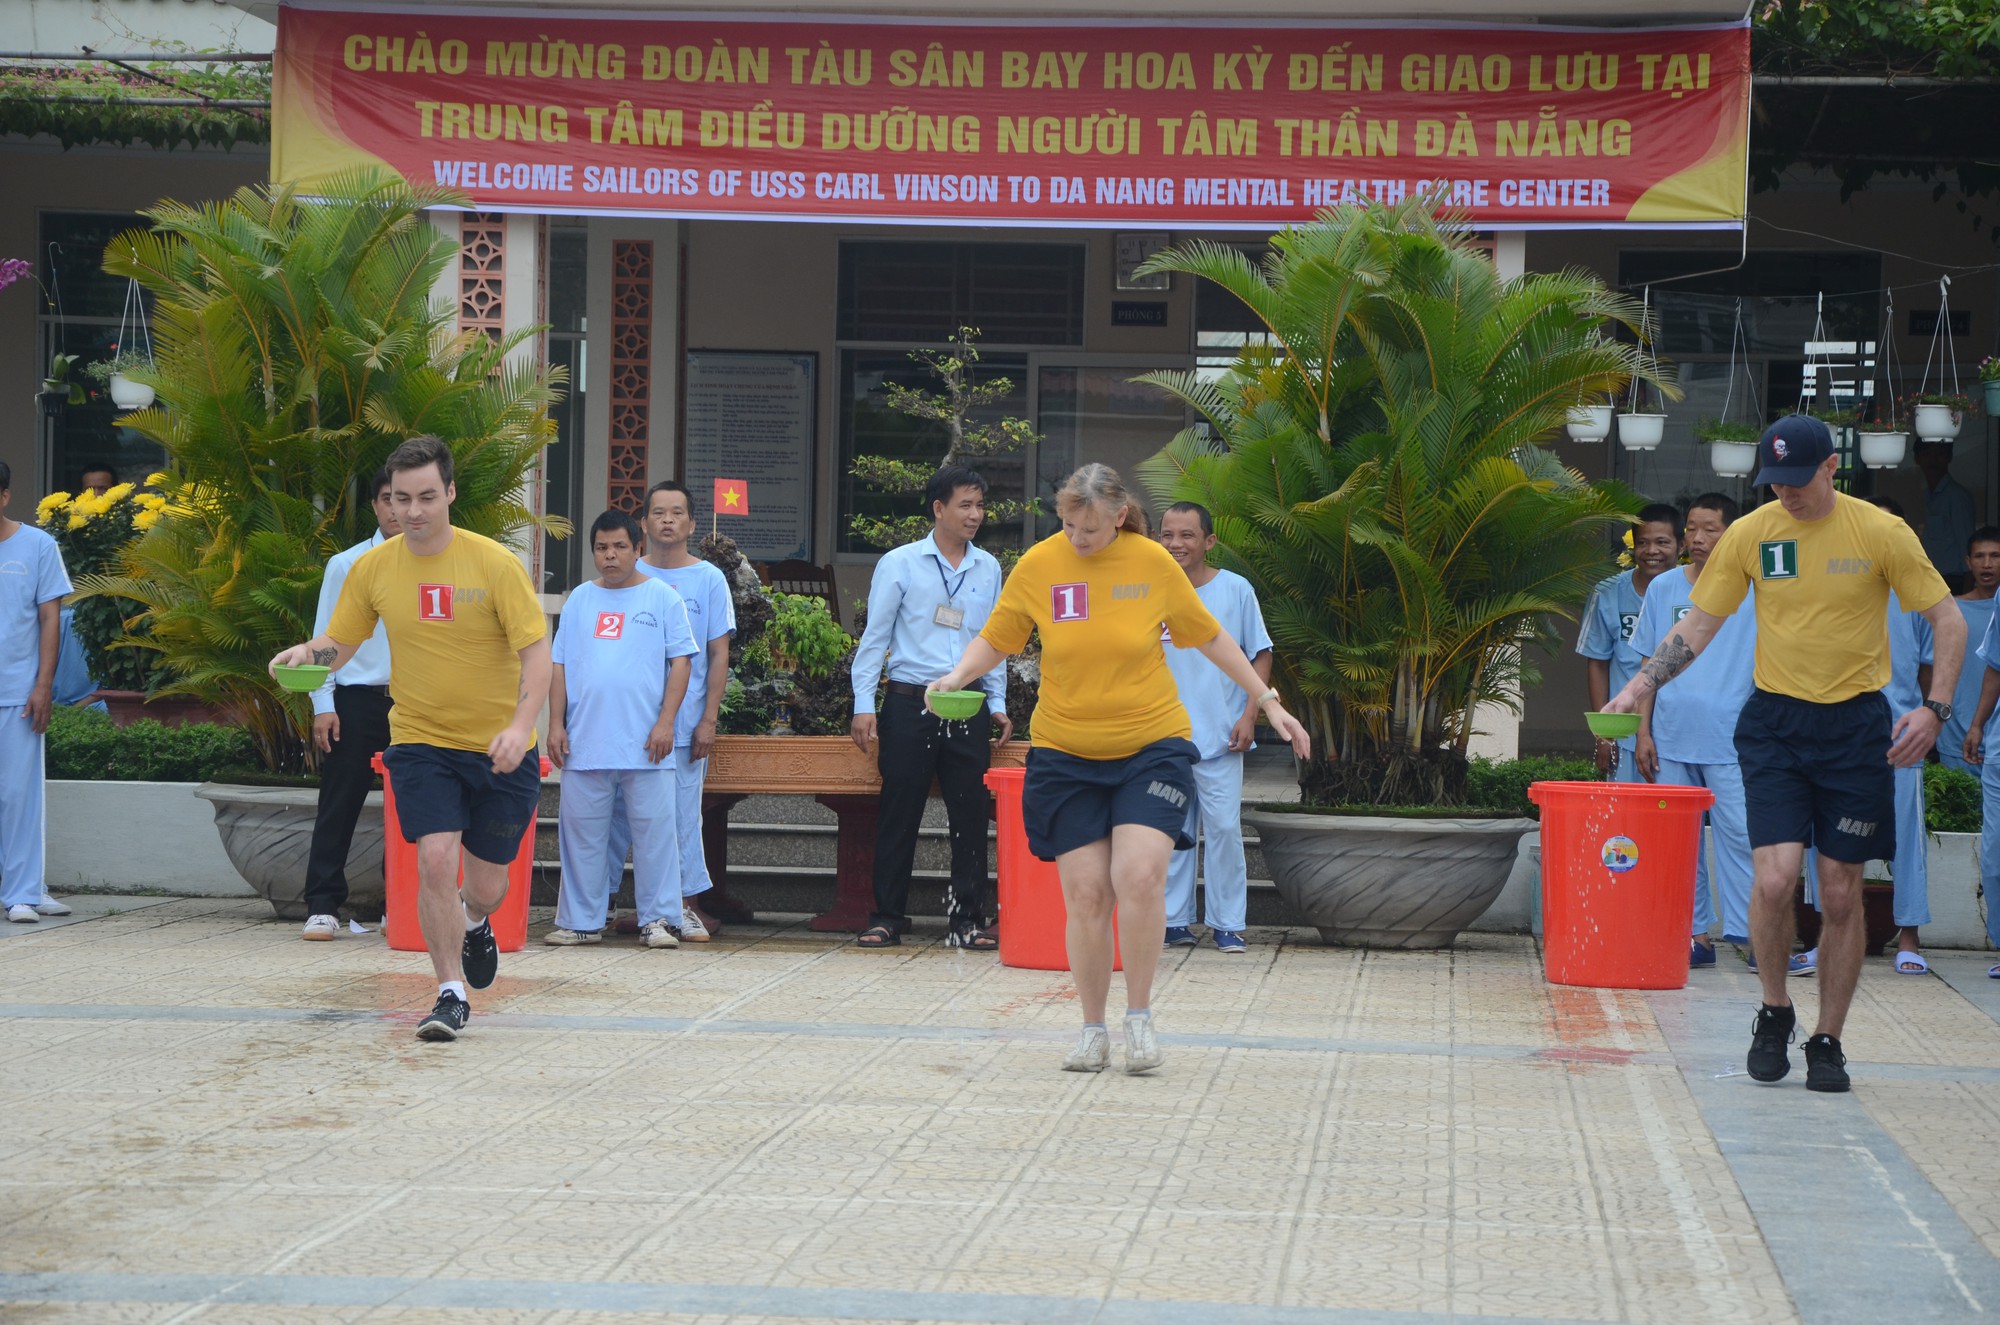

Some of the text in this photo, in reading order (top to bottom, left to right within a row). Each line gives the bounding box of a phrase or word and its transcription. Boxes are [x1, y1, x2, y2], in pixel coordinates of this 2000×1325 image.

[344, 31, 1710, 98] CHÀO MỪNG ĐOÀN TÀU SÂN BAY HOA KỲ ĐẾN GIAO LƯU TẠI
[415, 100, 1631, 157] TRUNG TÂM ĐIỀU DƯỠNG NGƯỜI TÂM THẦN ĐÀ NẴNG
[433, 160, 1610, 208] WELCOME SAILORS OF USS CARL VINSON TO DA NANG MENTAL HEALTH CARE CENTER
[1768, 543, 1790, 576] 1
[1826, 556, 1873, 575] NAVY
[426, 587, 446, 617] 1
[453, 587, 488, 603] AVY
[1059, 586, 1080, 618] 1
[1111, 583, 1151, 600] NAVY
[599, 615, 620, 637] 2
[1146, 779, 1188, 809] NAVY
[1836, 816, 1879, 837] NAVY
